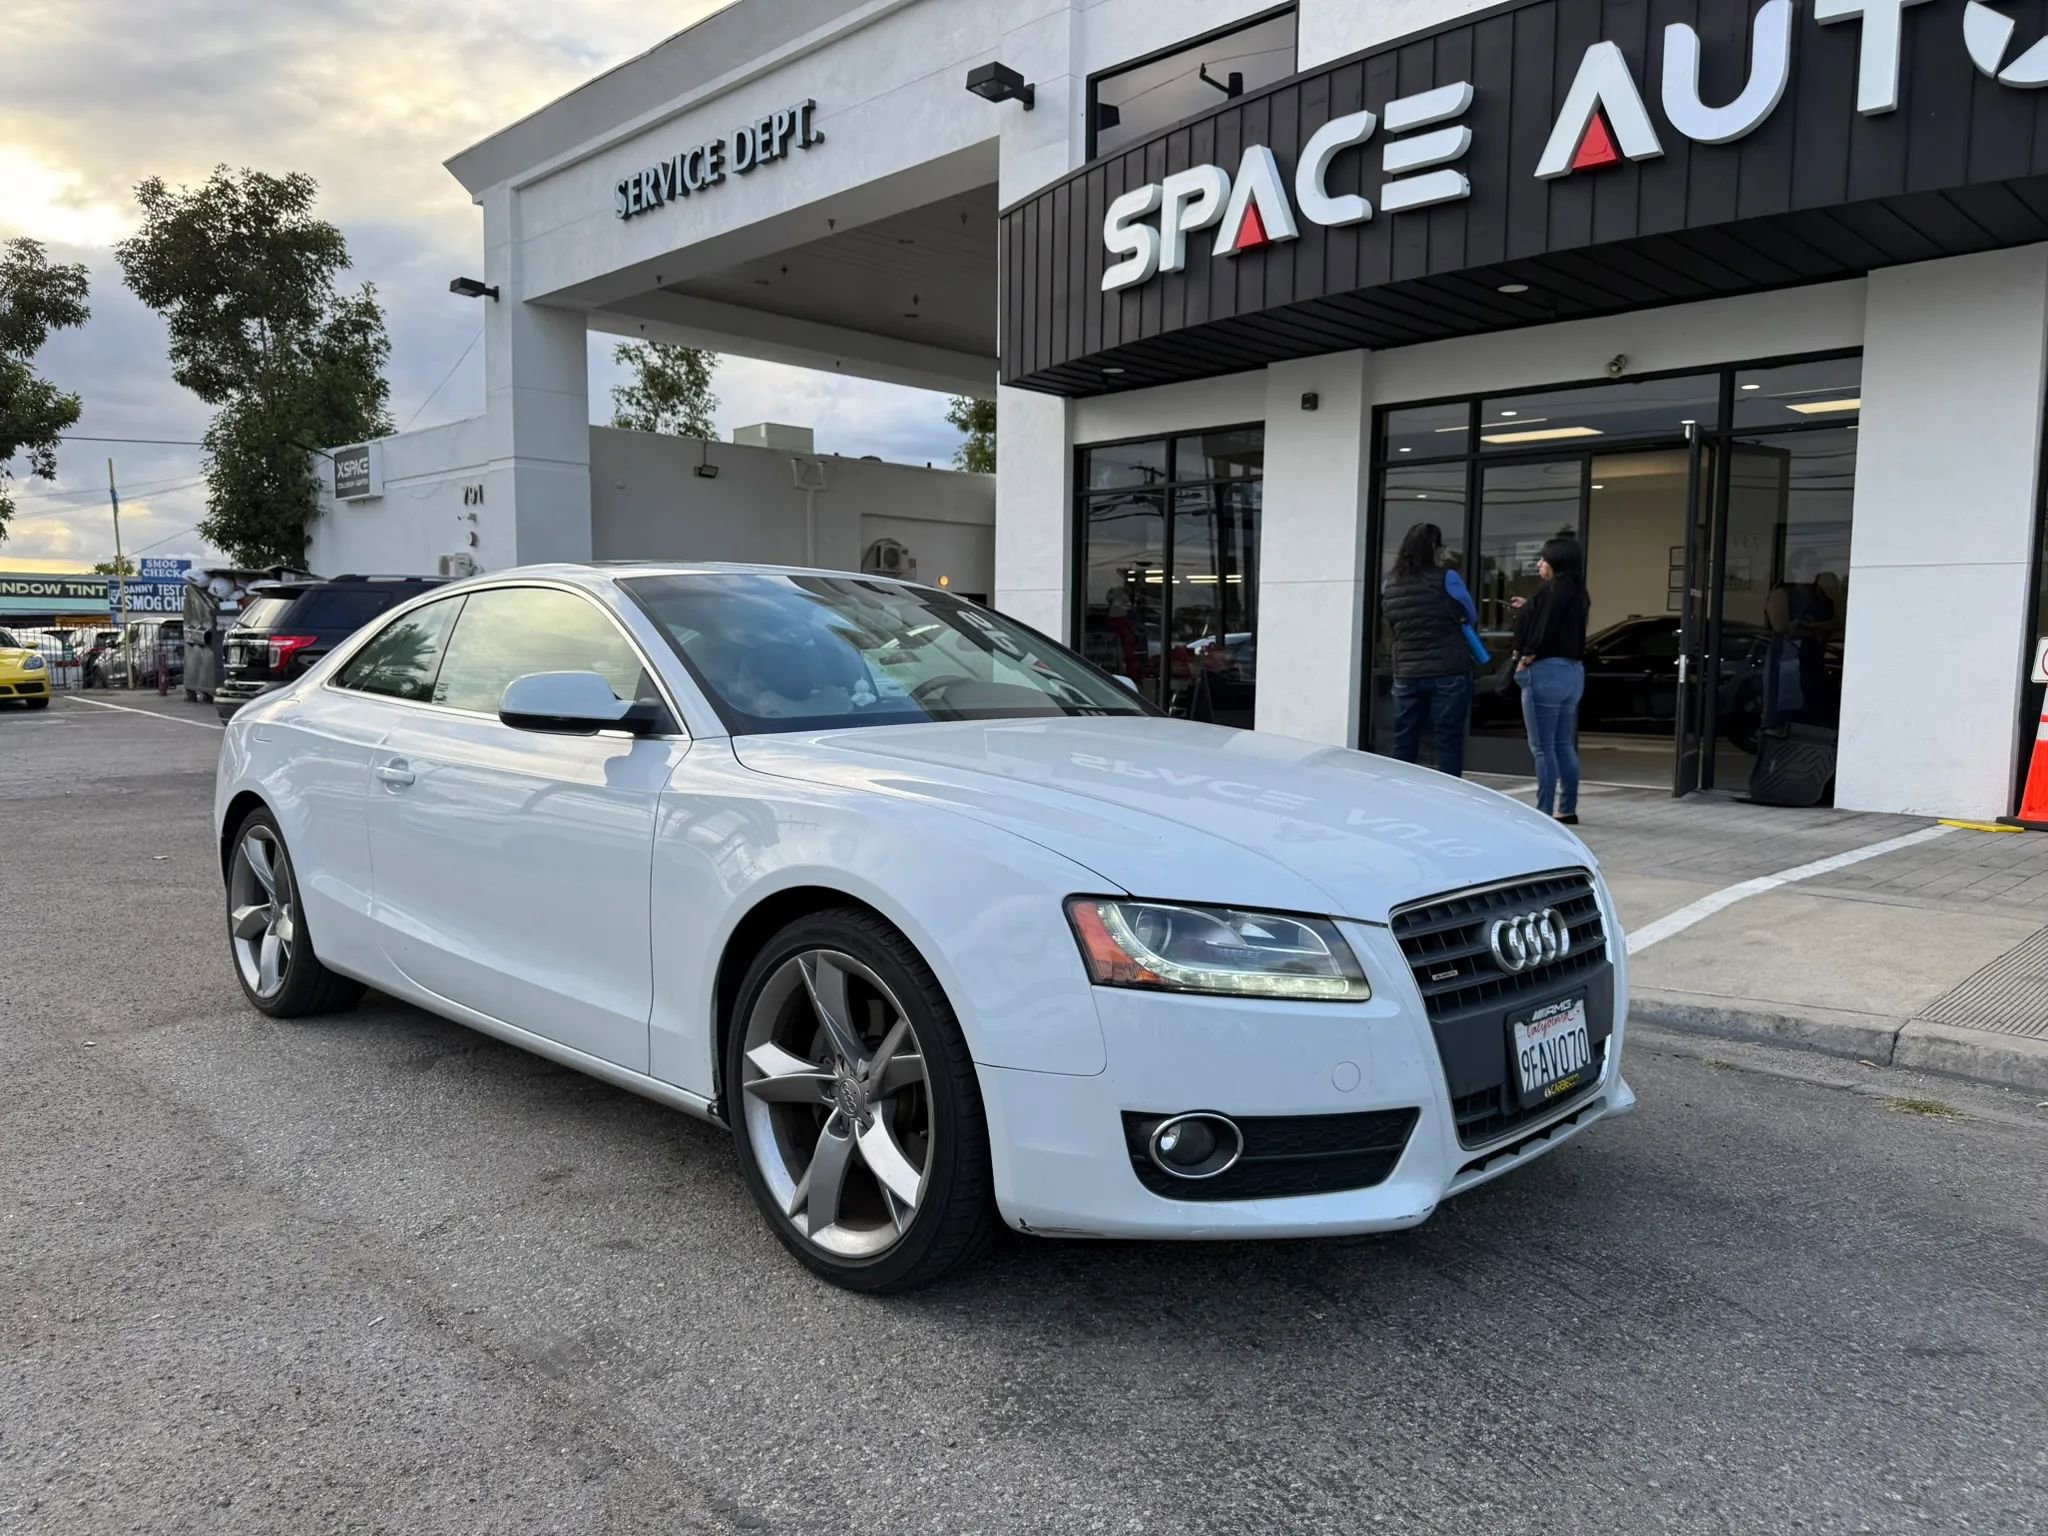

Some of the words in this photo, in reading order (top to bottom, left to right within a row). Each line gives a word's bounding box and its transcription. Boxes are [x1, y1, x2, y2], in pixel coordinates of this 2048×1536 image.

[614, 138, 726, 221] SERVICE
[731, 98, 825, 175] DEPT.
[1101, 79, 1474, 294] SPACE
[146, 559, 178, 568] SMOG
[142, 568, 181, 578] CHECK
[65, 584, 107, 596] TINT
[124, 584, 154, 594] DANNY
[157, 584, 181, 596] TEST
[125, 595, 162, 610] SMOG
[1526, 1011, 1574, 1038] California
[1521, 1027, 1589, 1094] 9FAV070
